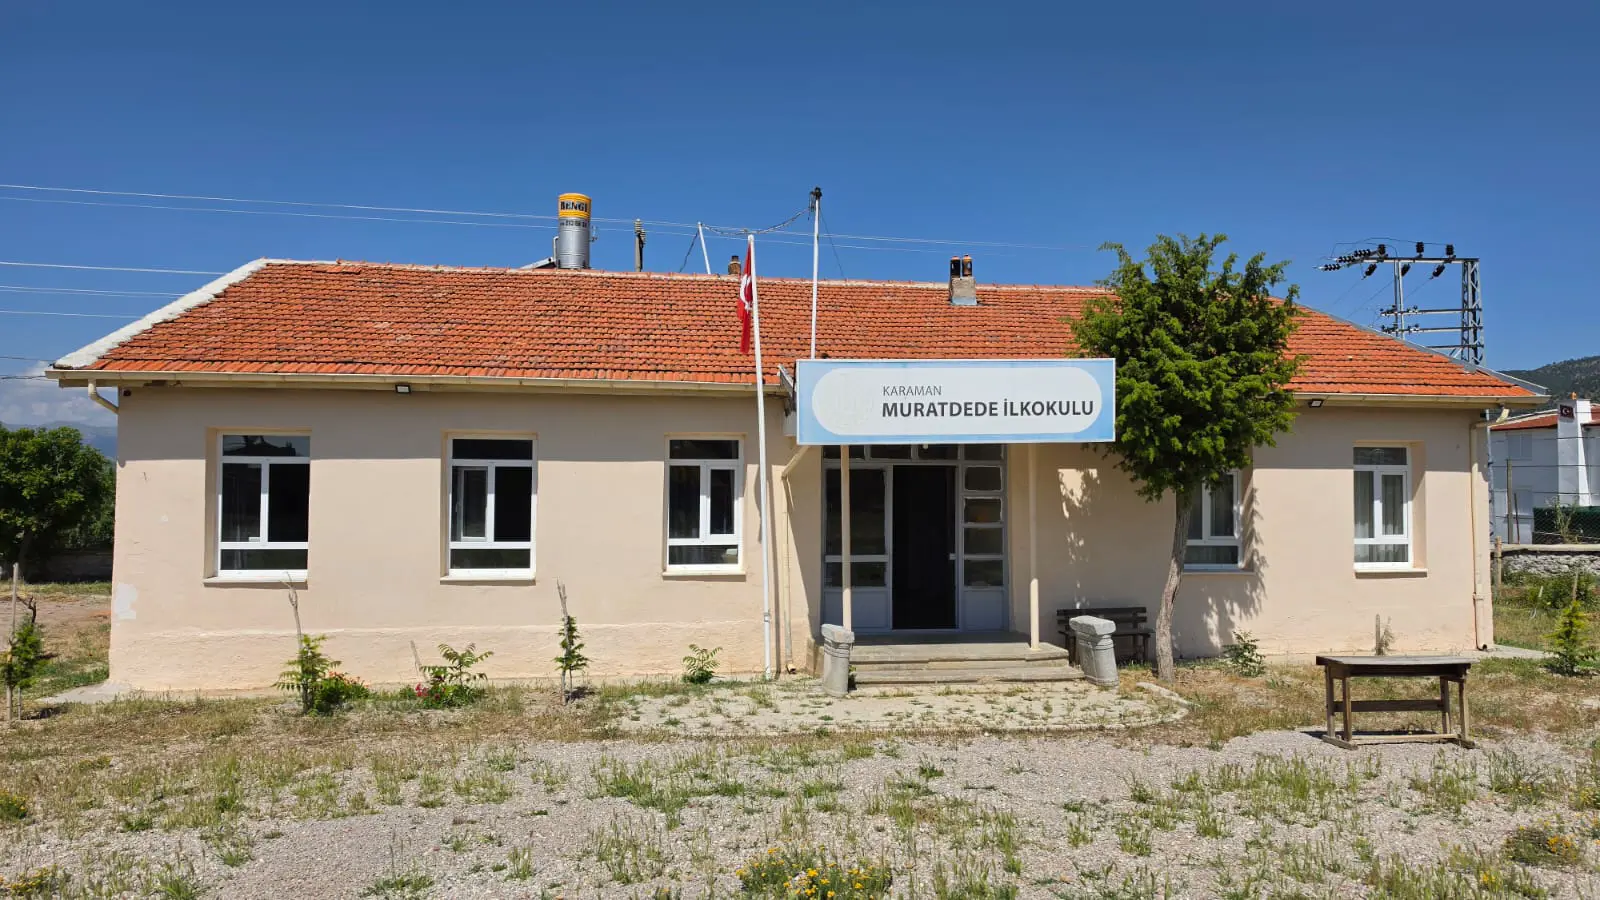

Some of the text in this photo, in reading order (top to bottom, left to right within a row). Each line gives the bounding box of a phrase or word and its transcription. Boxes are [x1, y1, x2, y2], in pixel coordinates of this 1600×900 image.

[883, 385, 942, 397] KARAMAN
[882, 398, 1094, 417] MURATDEDE İLKOKULU
